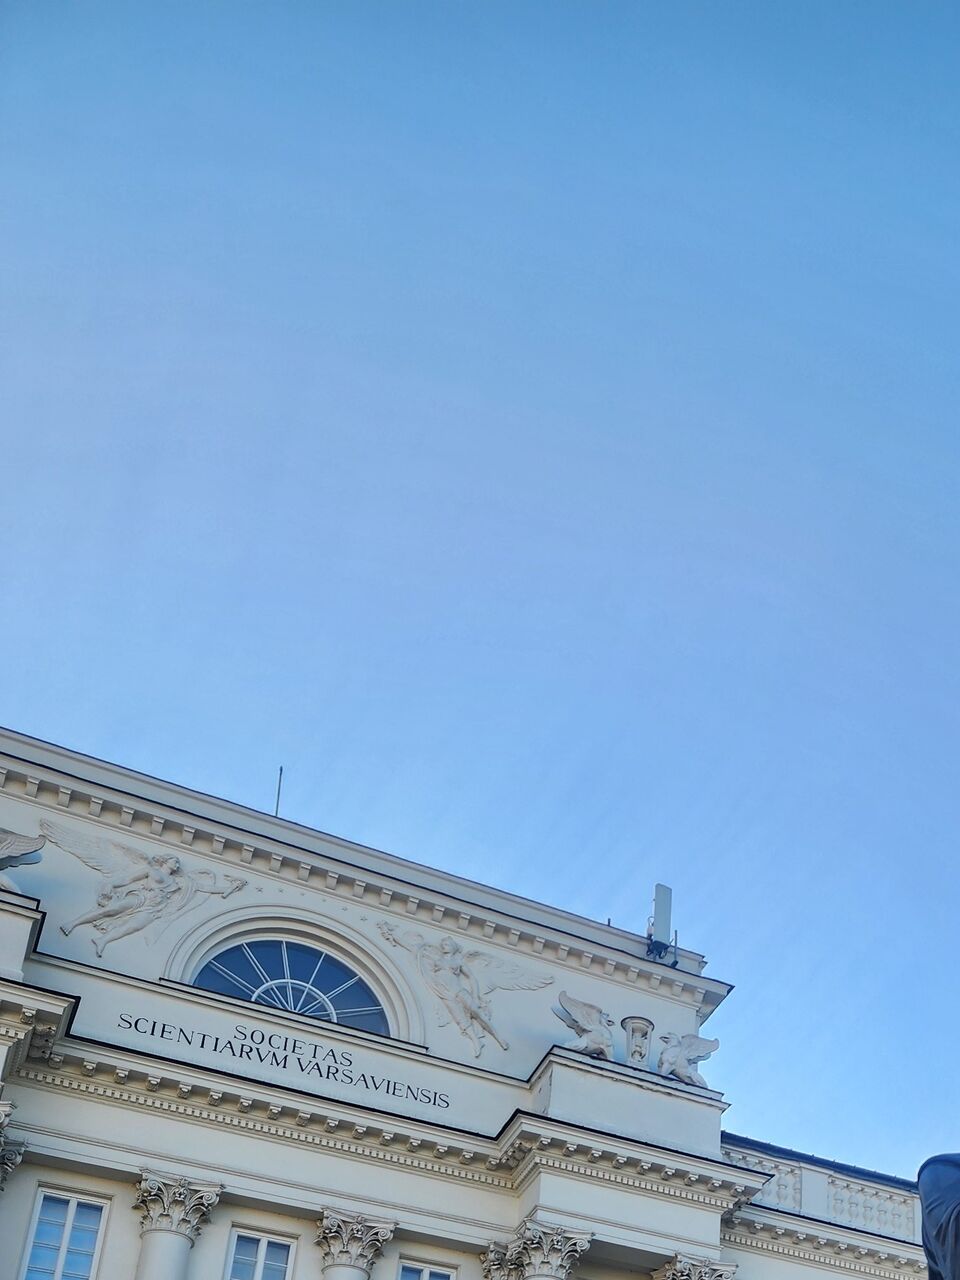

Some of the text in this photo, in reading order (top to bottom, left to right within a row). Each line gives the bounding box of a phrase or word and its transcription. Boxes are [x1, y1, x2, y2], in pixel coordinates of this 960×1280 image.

[117, 1013, 451, 1109] SCIENTIARVM VARSAVIENSIS
[233, 1025, 353, 1067] SOCIETAS
